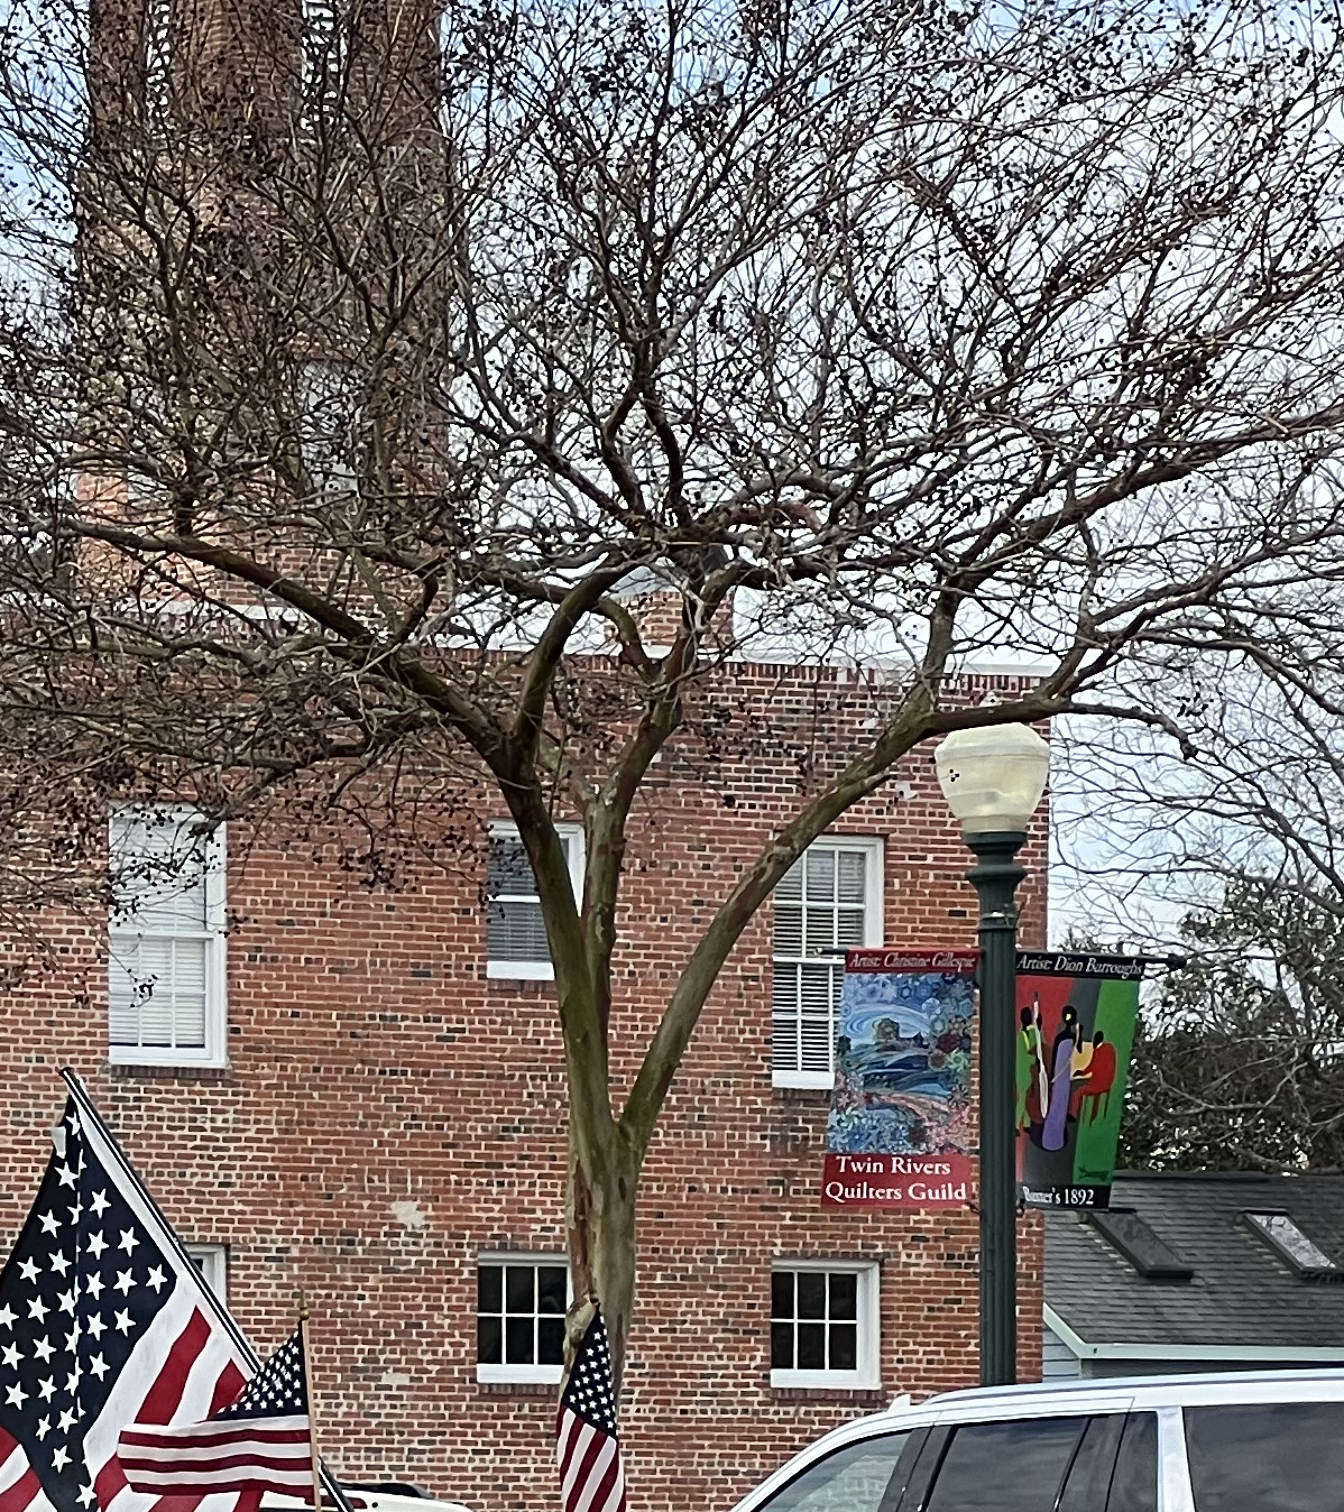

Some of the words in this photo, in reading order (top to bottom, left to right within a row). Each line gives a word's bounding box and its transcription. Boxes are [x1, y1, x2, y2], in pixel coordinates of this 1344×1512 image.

[932, 952, 976, 973] Gillespie
[1053, 955, 1083, 972] Dion
[836, 1156, 884, 1174] Twin
[891, 1156, 951, 1175] Rivers
[825, 1181, 902, 1202] Quilters
[908, 1181, 967, 1201] Guild
[1064, 1188, 1095, 1206] 1892
